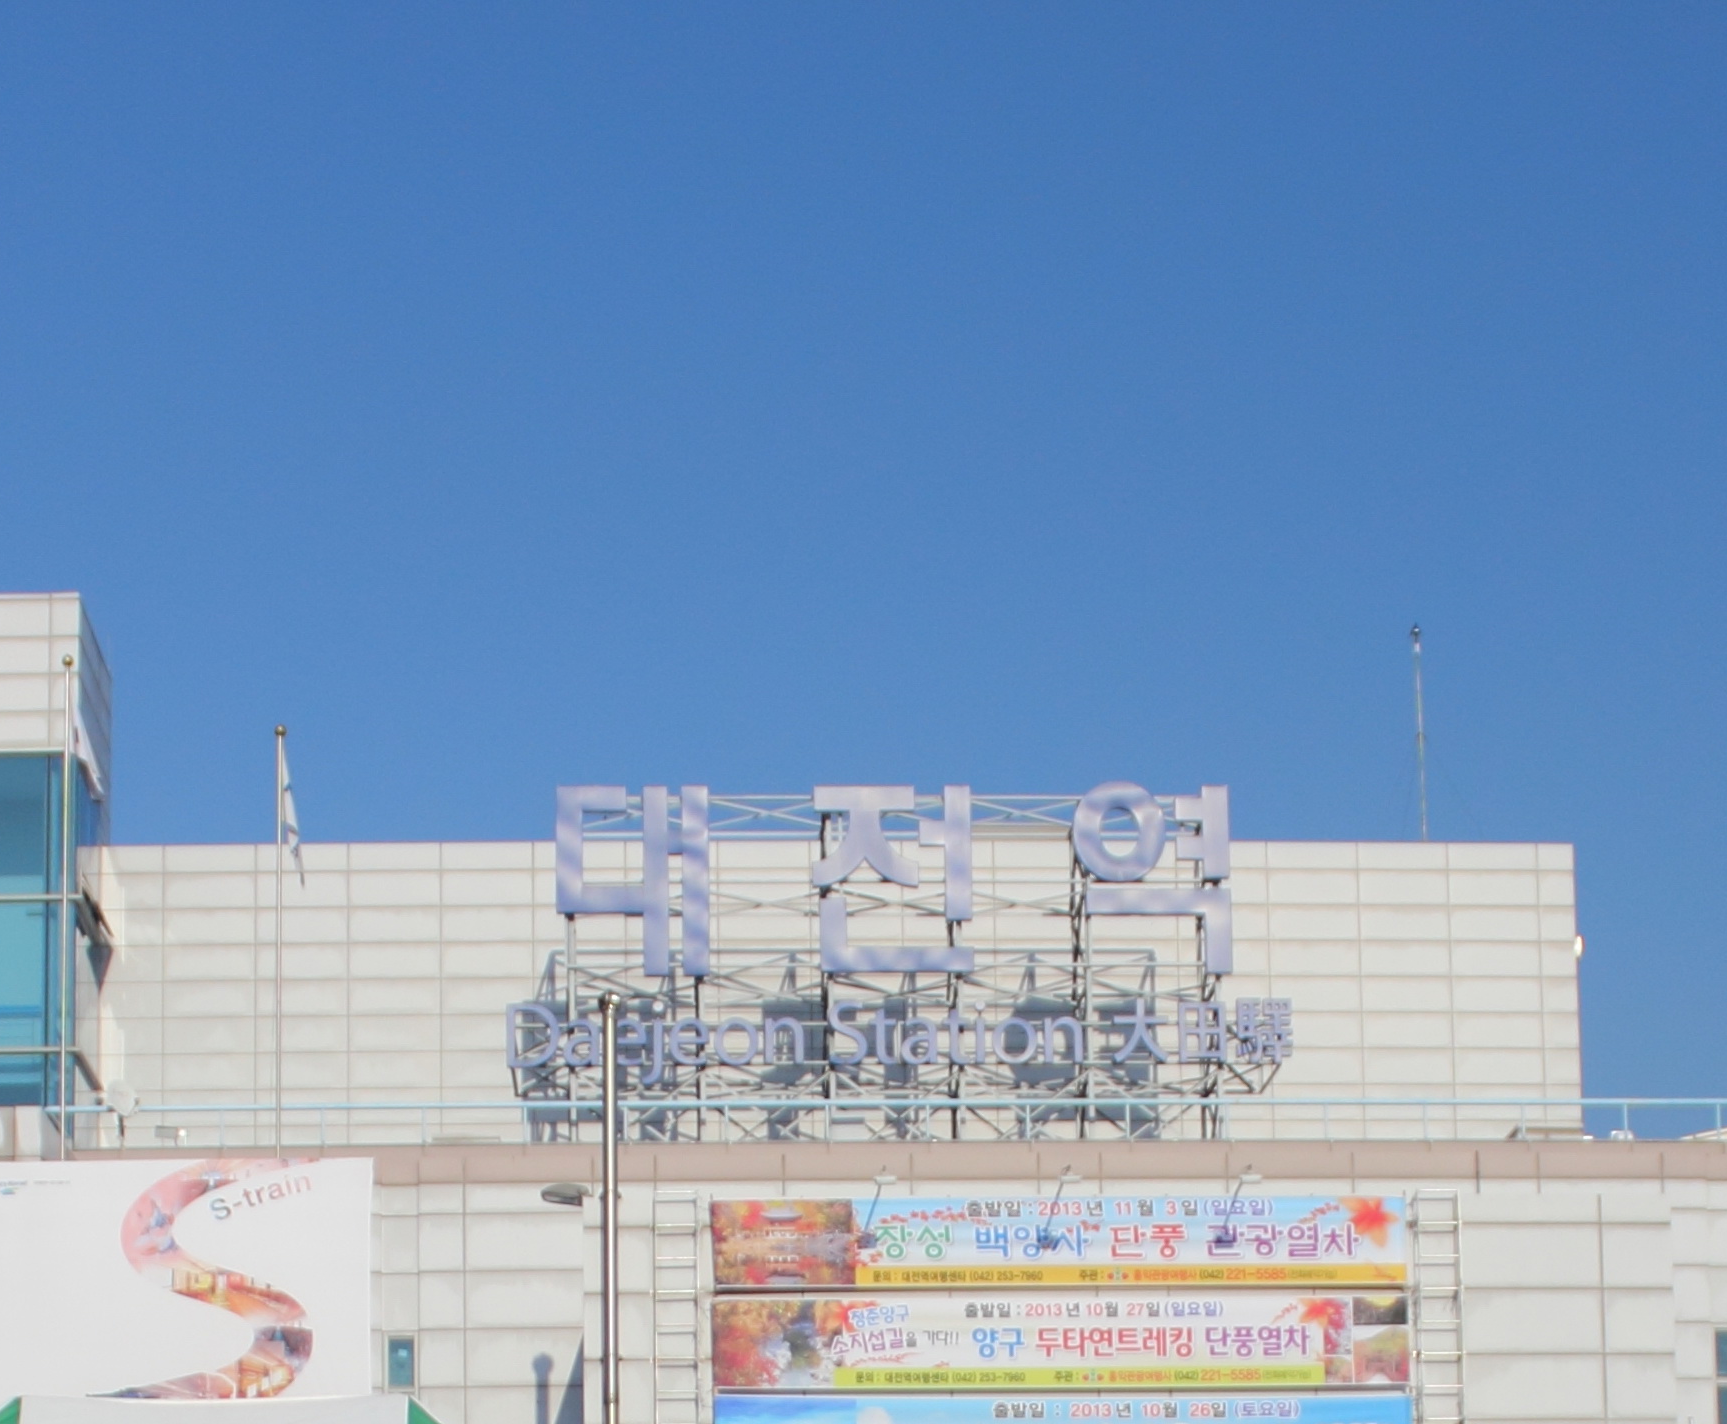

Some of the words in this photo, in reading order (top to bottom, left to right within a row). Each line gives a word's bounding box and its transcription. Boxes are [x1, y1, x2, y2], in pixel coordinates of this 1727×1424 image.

[556, 781, 1233, 976] 대전역
[505, 1001, 805, 1085] Daejeon
[830, 1000, 1085, 1067] Station
[209, 1171, 314, 1221] S-train
[966, 1200, 1022, 1217] 출발일
[874, 1223, 953, 1259] 장성
[974, 1223, 1091, 1259] 백양사
[1109, 1222, 1187, 1259] 단풍
[1205, 1222, 1361, 1258] 관광열차
[964, 1302, 1012, 1319] 출발일
[972, 1326, 1024, 1358] 양구
[1035, 1325, 1195, 1359] 두타연트레킹
[1204, 1324, 1311, 1358] 단풍열차
[993, 1401, 1046, 1419] 출발일
